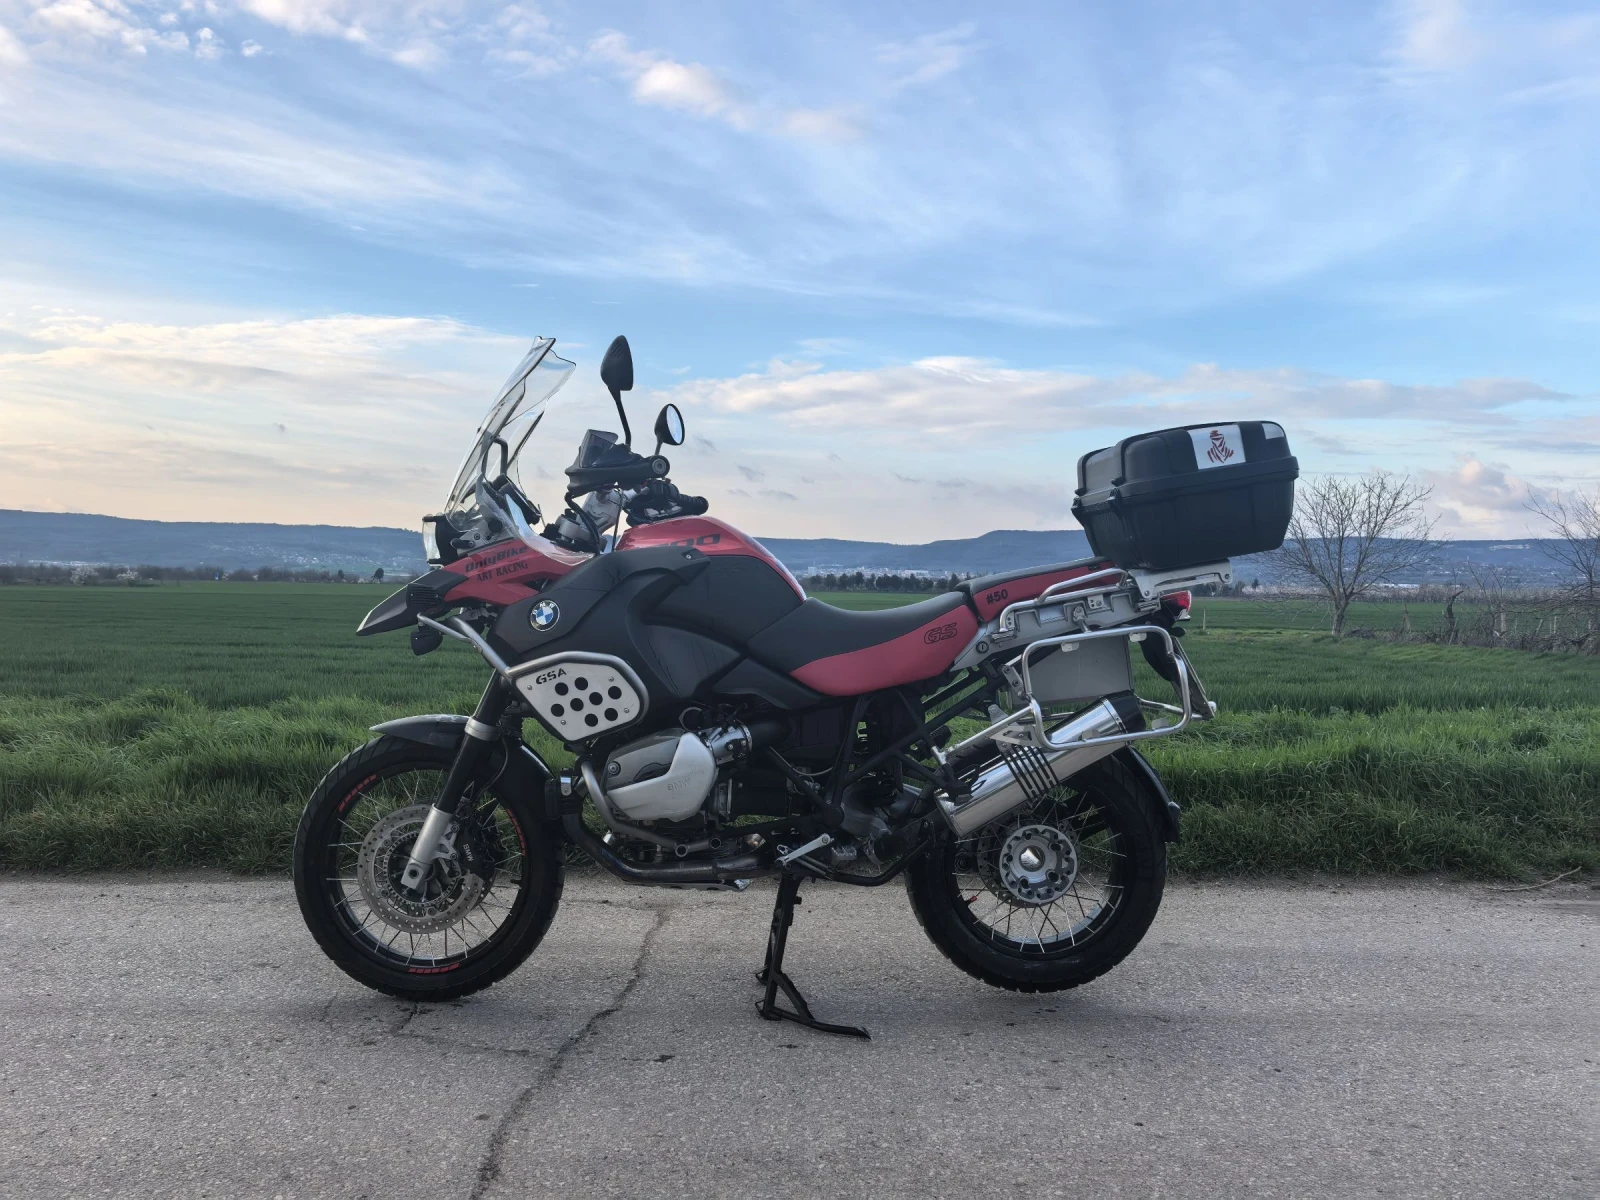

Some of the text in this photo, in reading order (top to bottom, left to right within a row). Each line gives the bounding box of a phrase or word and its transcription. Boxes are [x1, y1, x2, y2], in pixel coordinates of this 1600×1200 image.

[477, 560, 529, 583] ART RACING
[986, 588, 1009, 605] #50
[532, 602, 556, 615] BMW
[924, 622, 958, 645] GS
[535, 667, 567, 685] GSA
[463, 843, 474, 862] BMW
